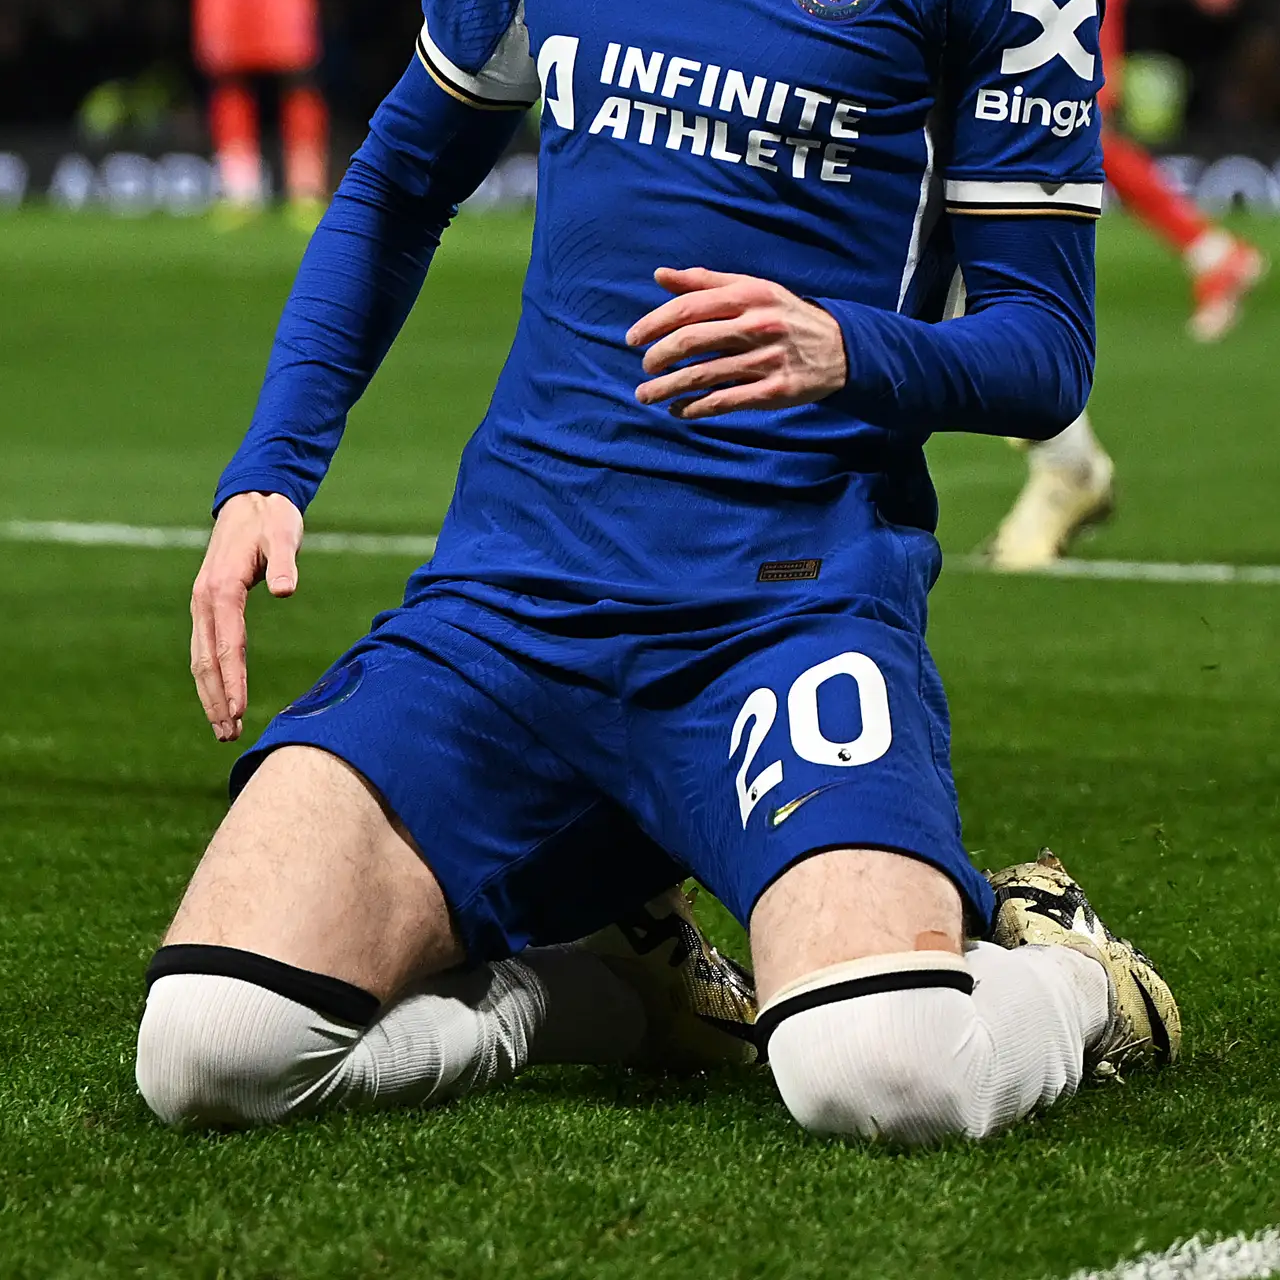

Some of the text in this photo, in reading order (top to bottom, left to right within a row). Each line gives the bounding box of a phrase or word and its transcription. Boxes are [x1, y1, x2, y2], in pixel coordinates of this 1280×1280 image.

[599, 42, 867, 139] INFINITE
[589, 96, 858, 183] ATHLETE
[729, 651, 893, 830] 20
